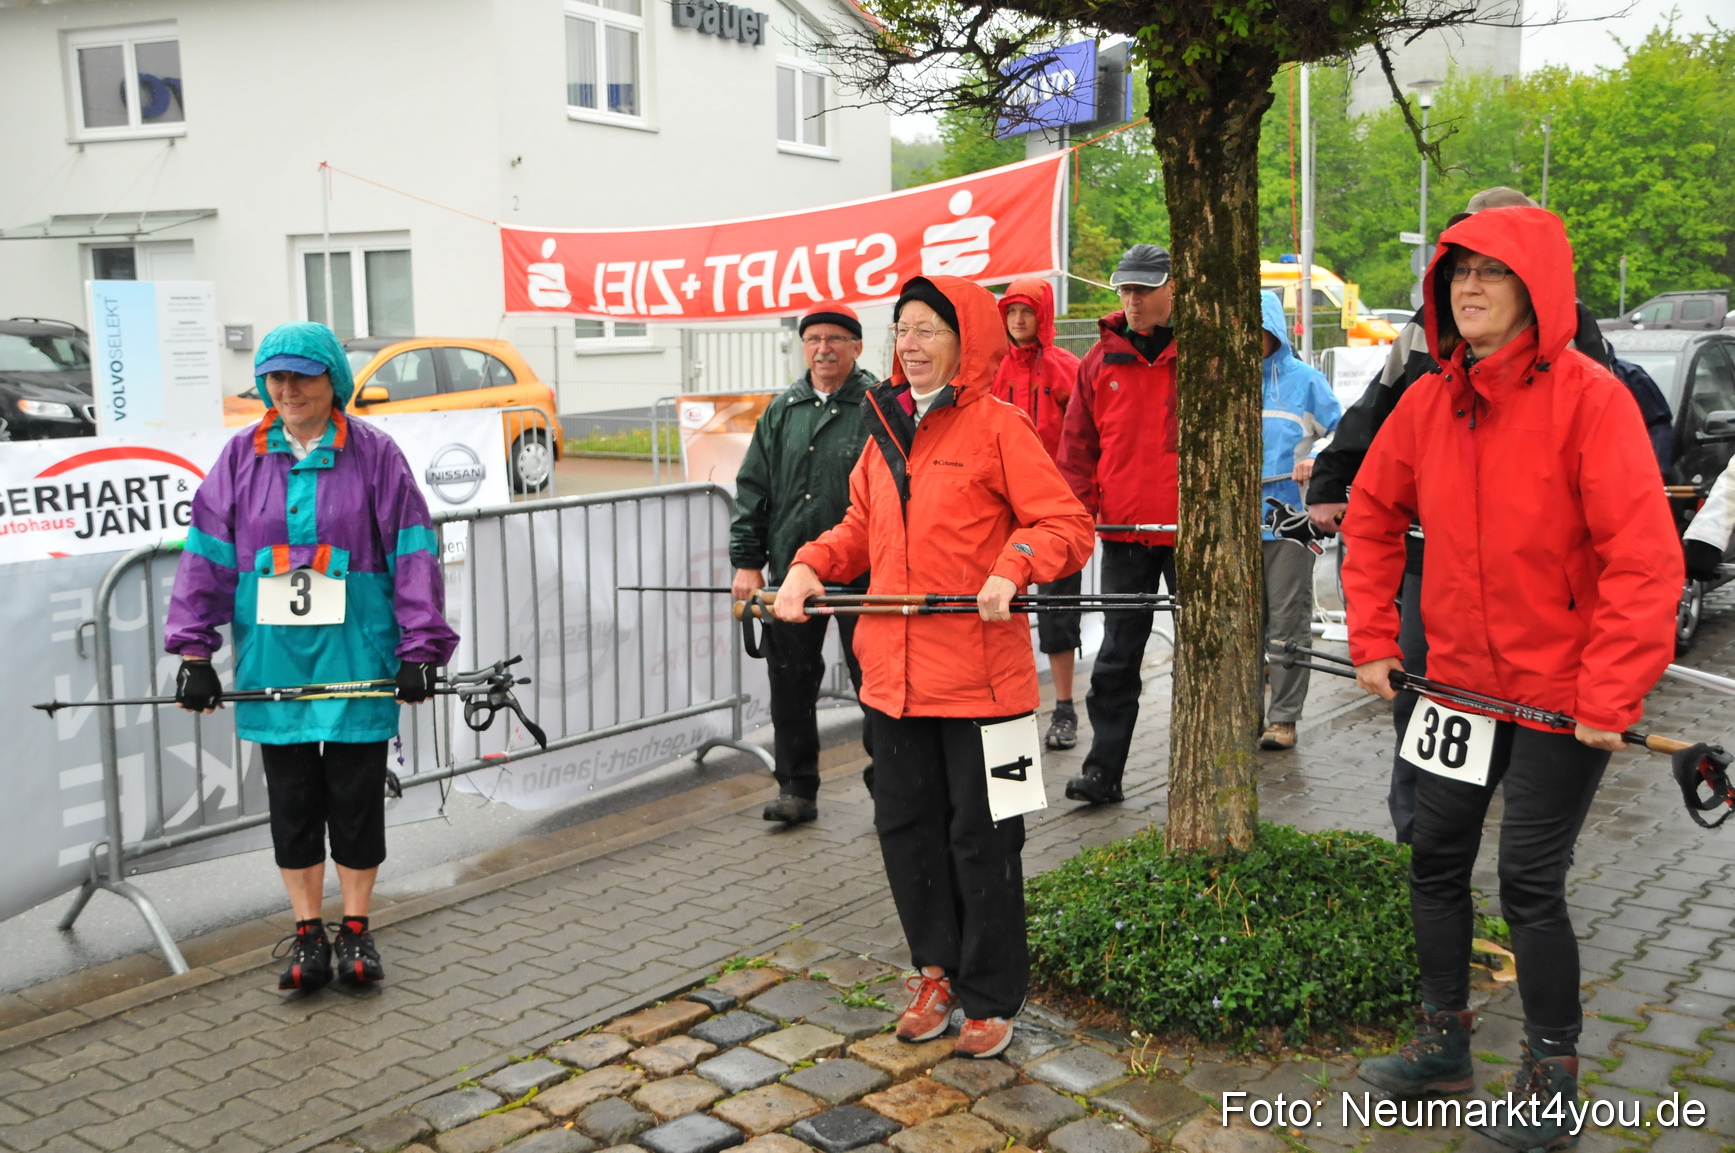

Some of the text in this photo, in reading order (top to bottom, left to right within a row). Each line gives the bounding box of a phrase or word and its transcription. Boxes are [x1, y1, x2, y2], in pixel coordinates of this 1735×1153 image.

[672, 0, 769, 46] Bauer
[0, 474, 189, 518] ERHART &
[431, 467, 481, 481] NISSAN
[290, 571, 312, 617] 3
[1416, 706, 1472, 769] 38
[990, 755, 1033, 782] 4
